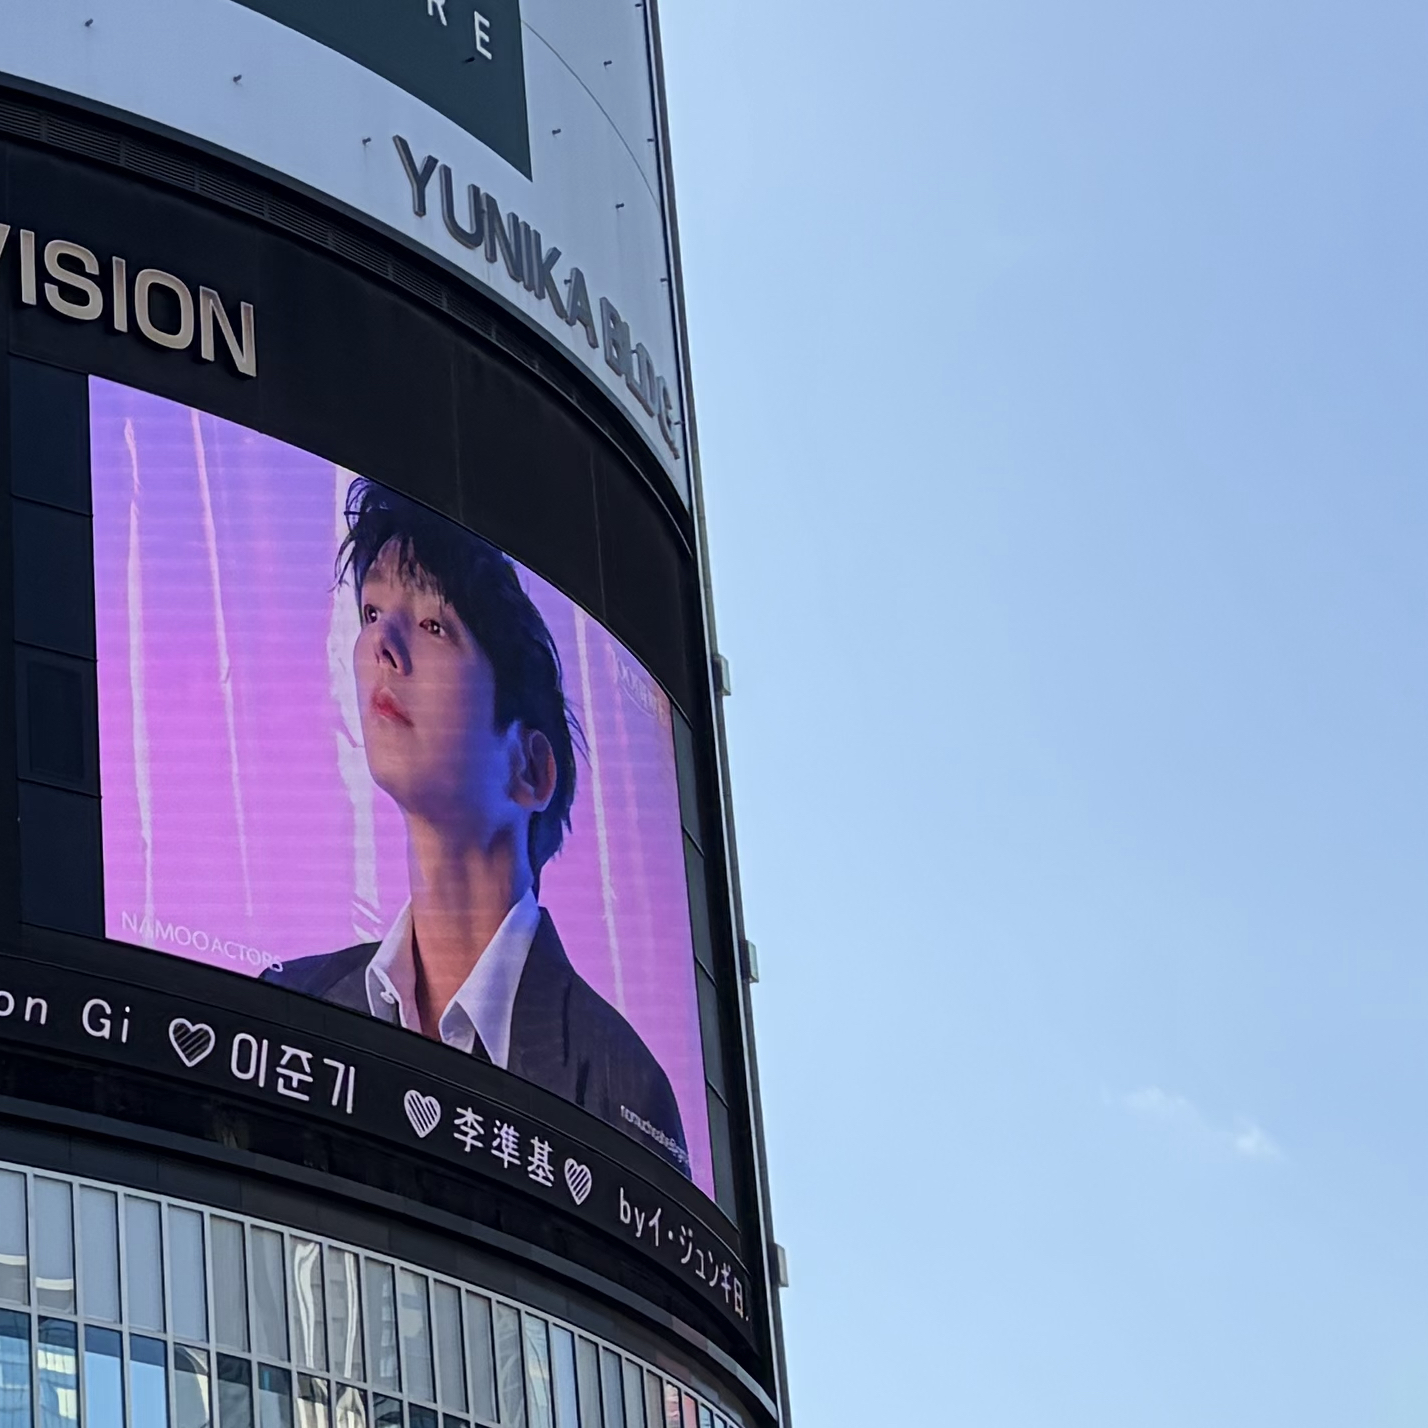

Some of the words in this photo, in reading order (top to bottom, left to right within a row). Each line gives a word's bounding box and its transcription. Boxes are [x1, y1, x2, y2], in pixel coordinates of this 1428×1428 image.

[392, 133, 599, 349] YUNIKA
[82, 998, 130, 1044] Gi
[230, 1032, 357, 1115] 이준기
[452, 1106, 556, 1188] 李準基
